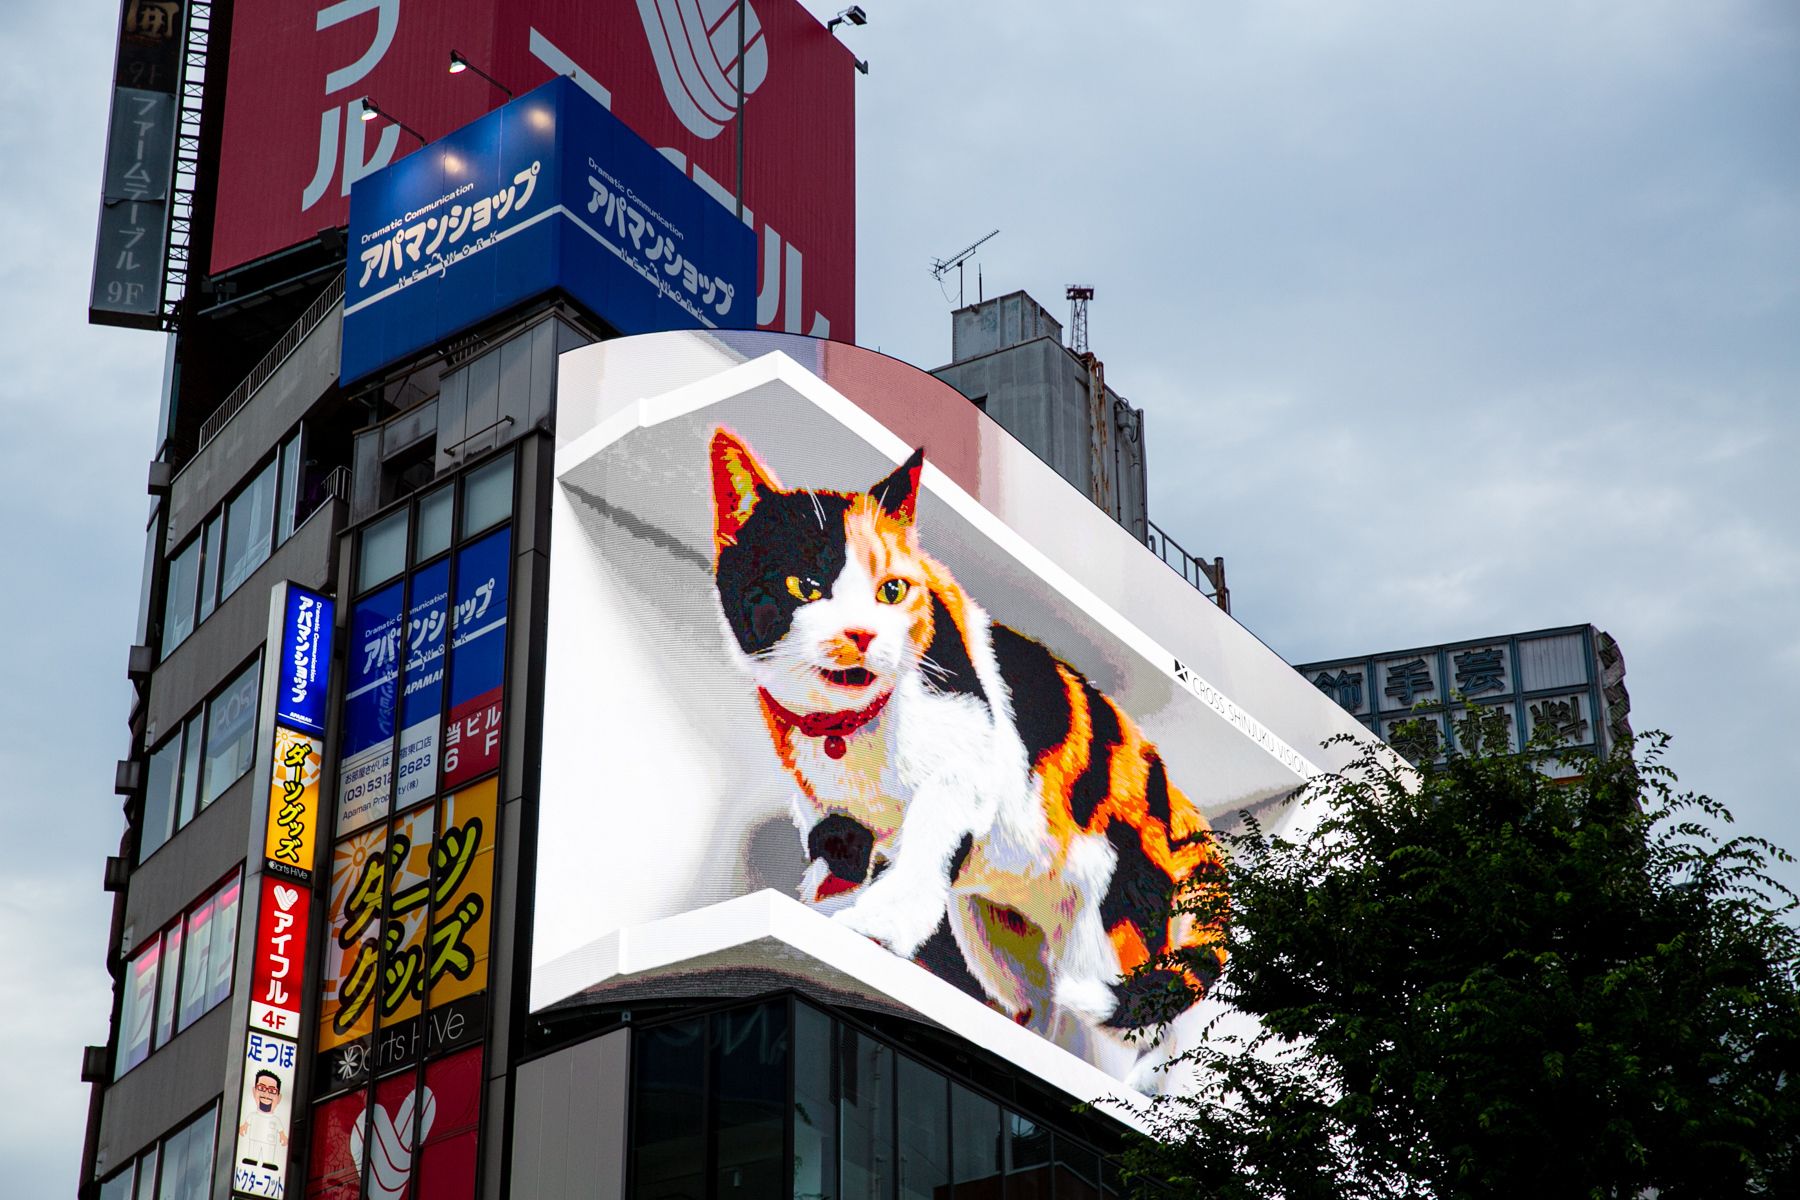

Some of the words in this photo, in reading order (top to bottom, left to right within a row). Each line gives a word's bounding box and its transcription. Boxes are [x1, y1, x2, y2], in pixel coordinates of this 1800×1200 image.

[115, 97, 159, 271] ファームテーブル
[359, 160, 541, 288] アパマンショップ
[361, 218, 403, 245] Dramatic
[404, 183, 474, 222] Communication
[588, 156, 625, 193] Dramatic
[626, 188, 685, 240] Communication
[587, 175, 735, 315] アパマンショップ
[107, 280, 145, 305] 9F
[291, 595, 314, 703] アパマンショップ
[365, 618, 396, 638] Dramatic
[446, 706, 501, 747] 当ビル
[1192, 677, 1225, 714] CROSS
[1228, 704, 1275, 752] SHINJUKU
[1276, 746, 1309, 779] VISION
[275, 743, 312, 863] ダーツグッズ
[343, 803, 372, 821] Apaman
[338, 816, 482, 949] ダーツ
[266, 910, 293, 1006] アイフル
[333, 892, 484, 1036] グッズ
[247, 1034, 294, 1069] 足つぼ
[261, 1010, 287, 1031] 4F
[233, 1166, 284, 1197] ドクターフット
